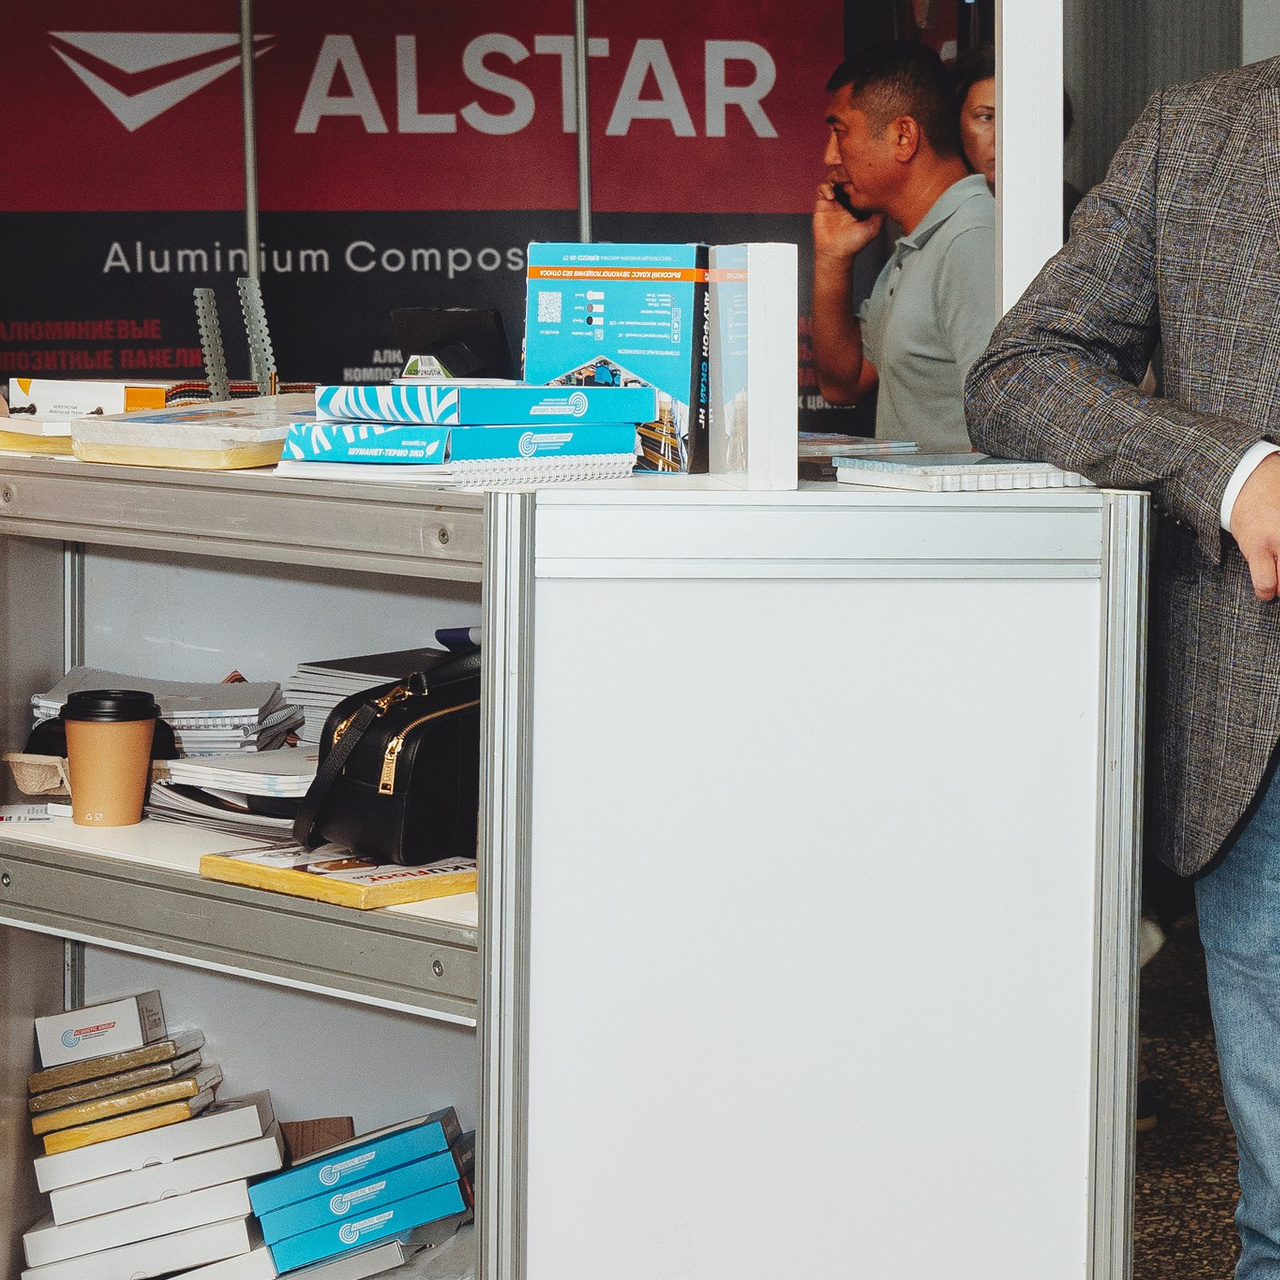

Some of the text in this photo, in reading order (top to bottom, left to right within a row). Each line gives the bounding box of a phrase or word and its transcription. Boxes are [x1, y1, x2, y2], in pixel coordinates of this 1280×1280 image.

[294, 32, 780, 139] ALSTAR
[102, 240, 330, 273] Aluminium
[631, 270, 651, 278] КЛАСС
[651, 271, 682, 279] ВЫСОКИЙ
[0, 348, 114, 371] ПОЗИТНЫЕ
[699, 361, 709, 404] СКАЙ
[698, 408, 707, 430] НГ
[348, 447, 425, 458] ШУМАНЕТ-ТЕРМО ЭКО
[74, 1022, 116, 1035] ACOUSTIC GROUP
[333, 1152, 375, 1172] ACOUSTIC GROUP
[344, 1182, 386, 1201] ACOUSTIC GROUP
[352, 1211, 393, 1231] ACOUSTIC GROUP
